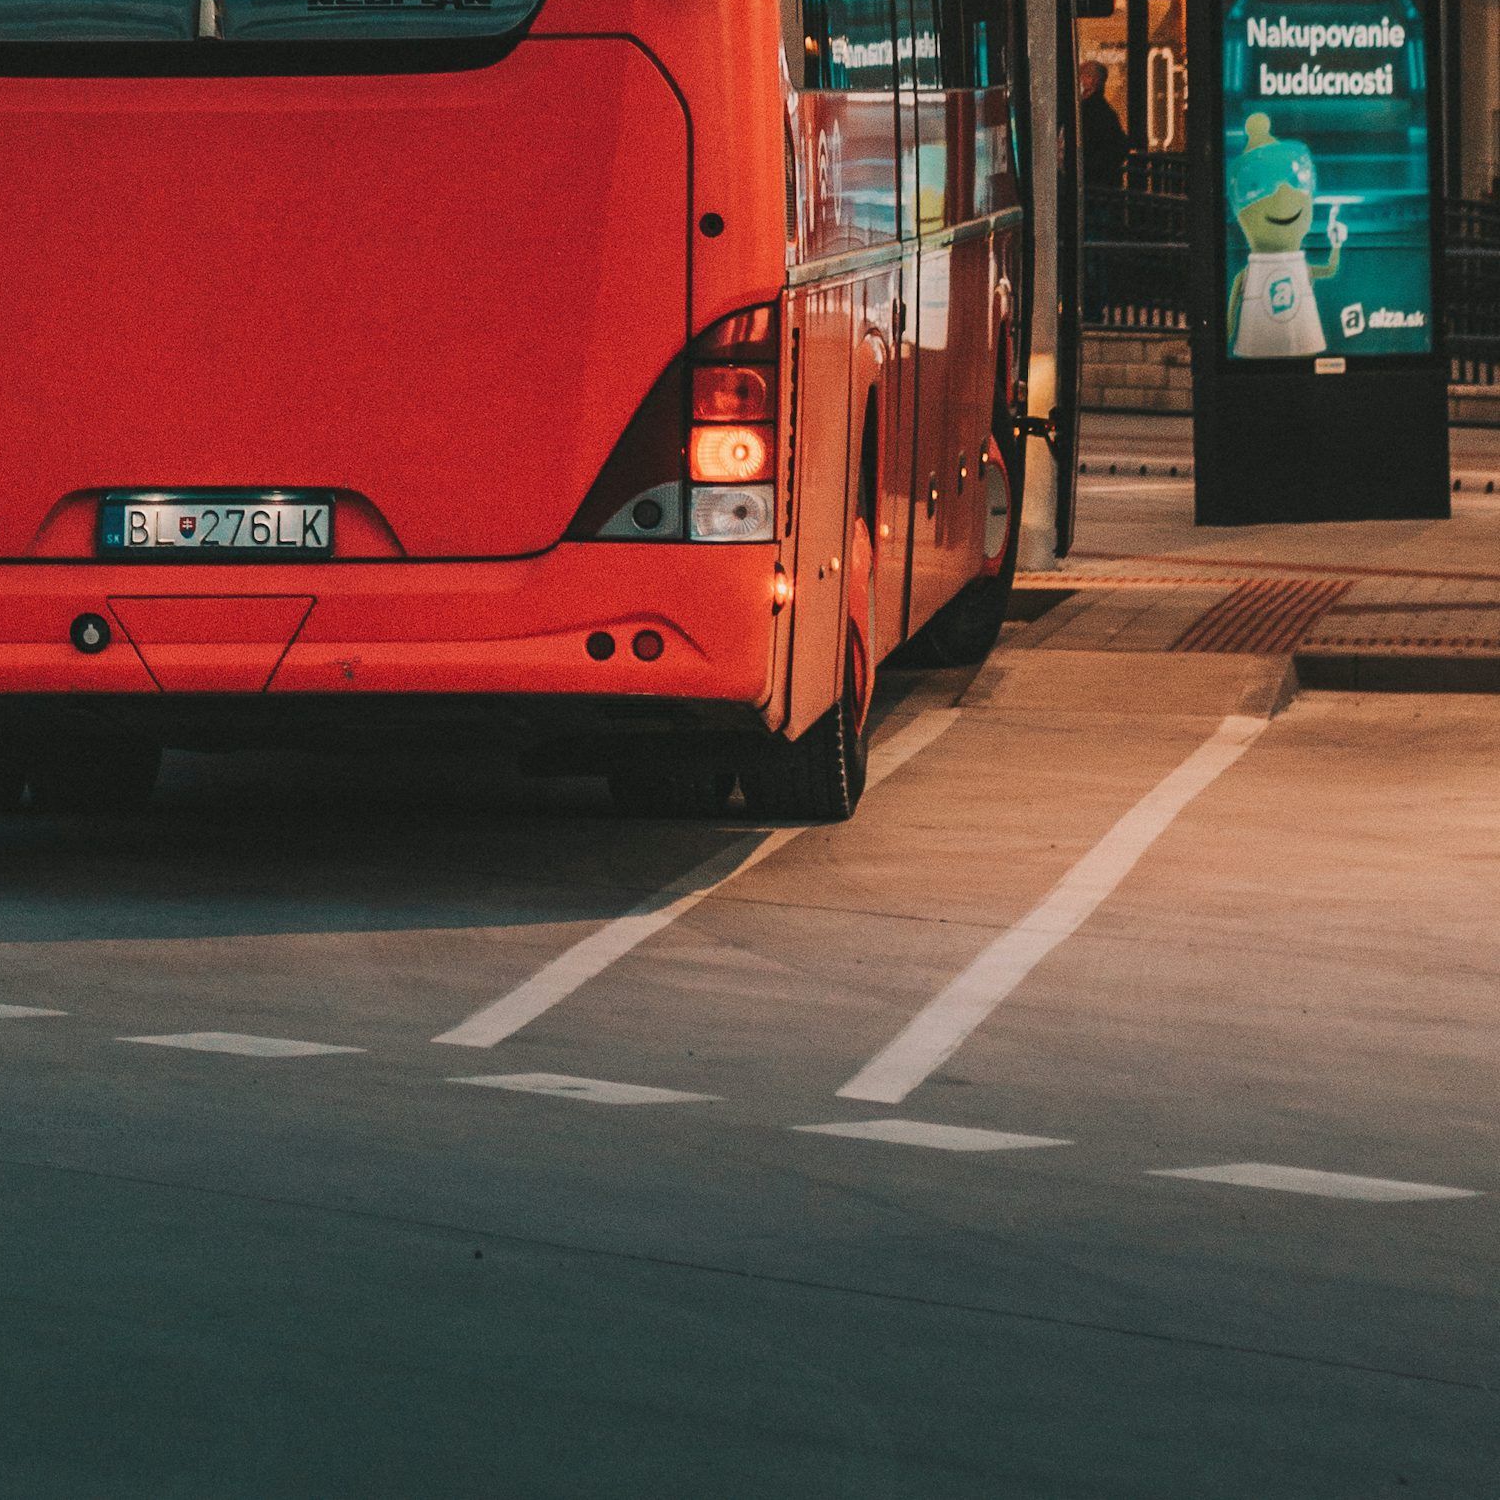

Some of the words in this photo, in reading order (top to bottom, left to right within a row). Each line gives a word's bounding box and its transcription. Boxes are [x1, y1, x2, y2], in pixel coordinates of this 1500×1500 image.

[1247, 16, 1405, 56] Nakupovanie
[1260, 63, 1393, 95] budúcnosti
[106, 533, 121, 544] SK
[129, 511, 176, 546] BL
[200, 509, 323, 546] 276LK
